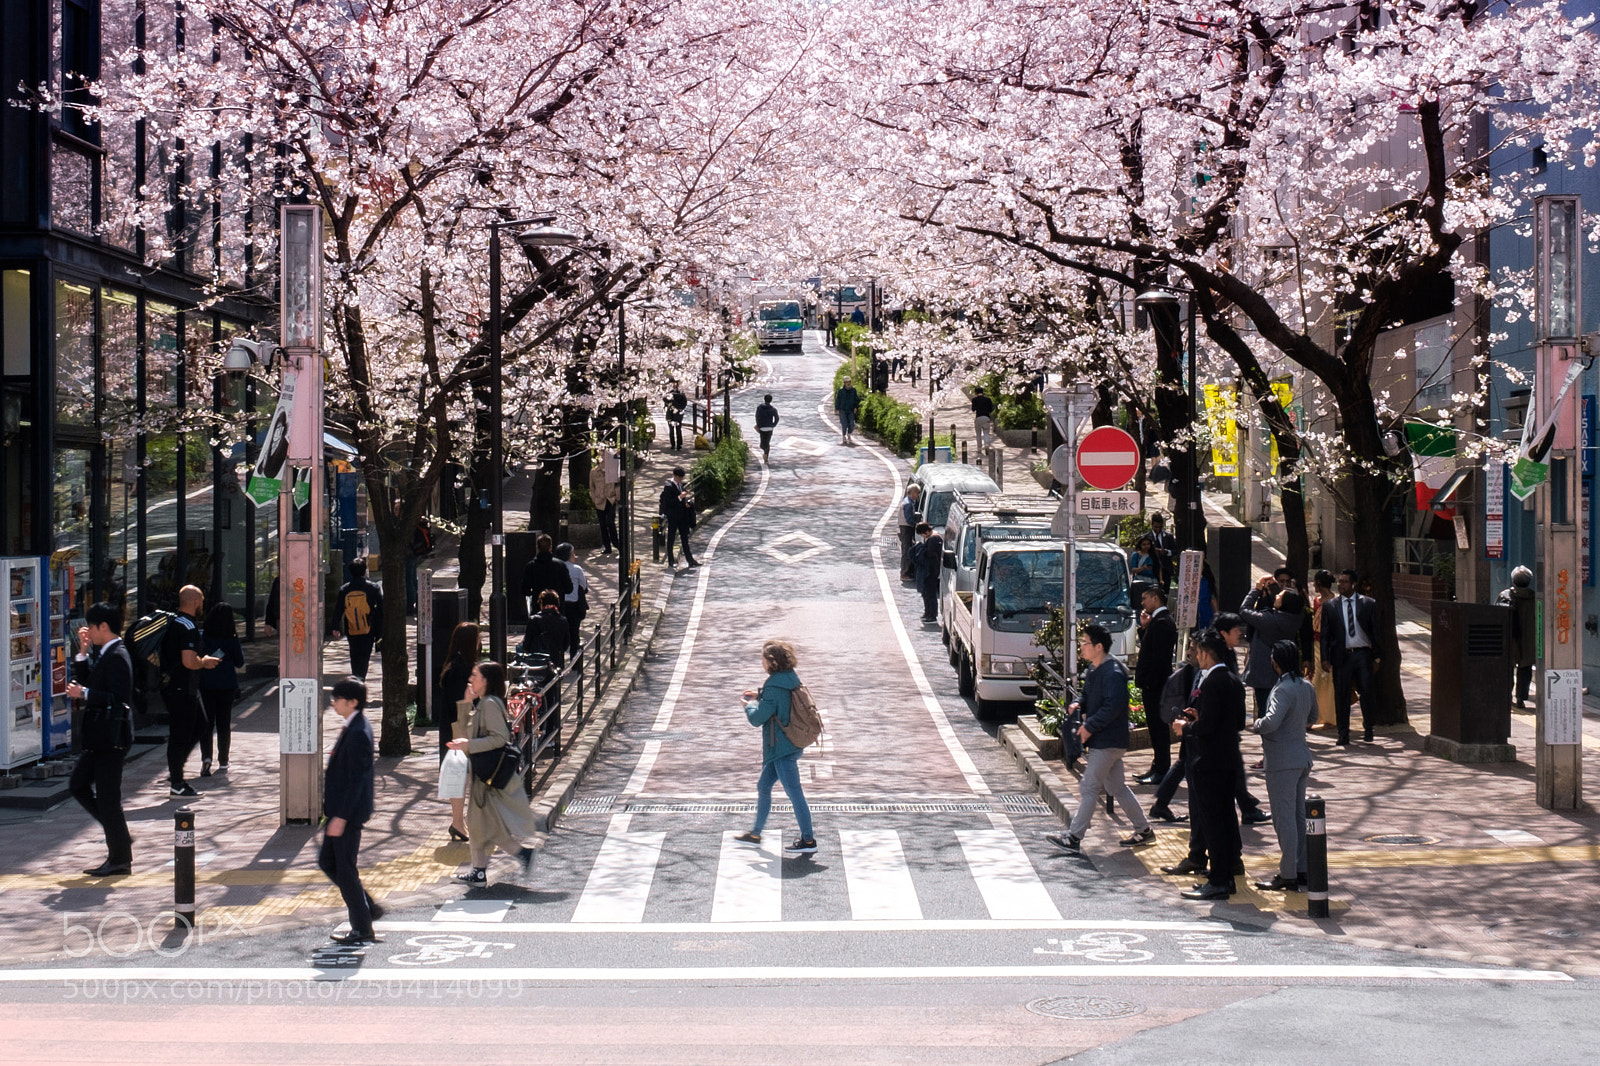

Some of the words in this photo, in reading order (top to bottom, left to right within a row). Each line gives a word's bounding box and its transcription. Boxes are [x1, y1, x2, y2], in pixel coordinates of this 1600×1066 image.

[1080, 496, 1136, 511] 自転車を除く
[292, 577, 306, 654] さくら通り
[1556, 568, 1571, 645] さくら通り
